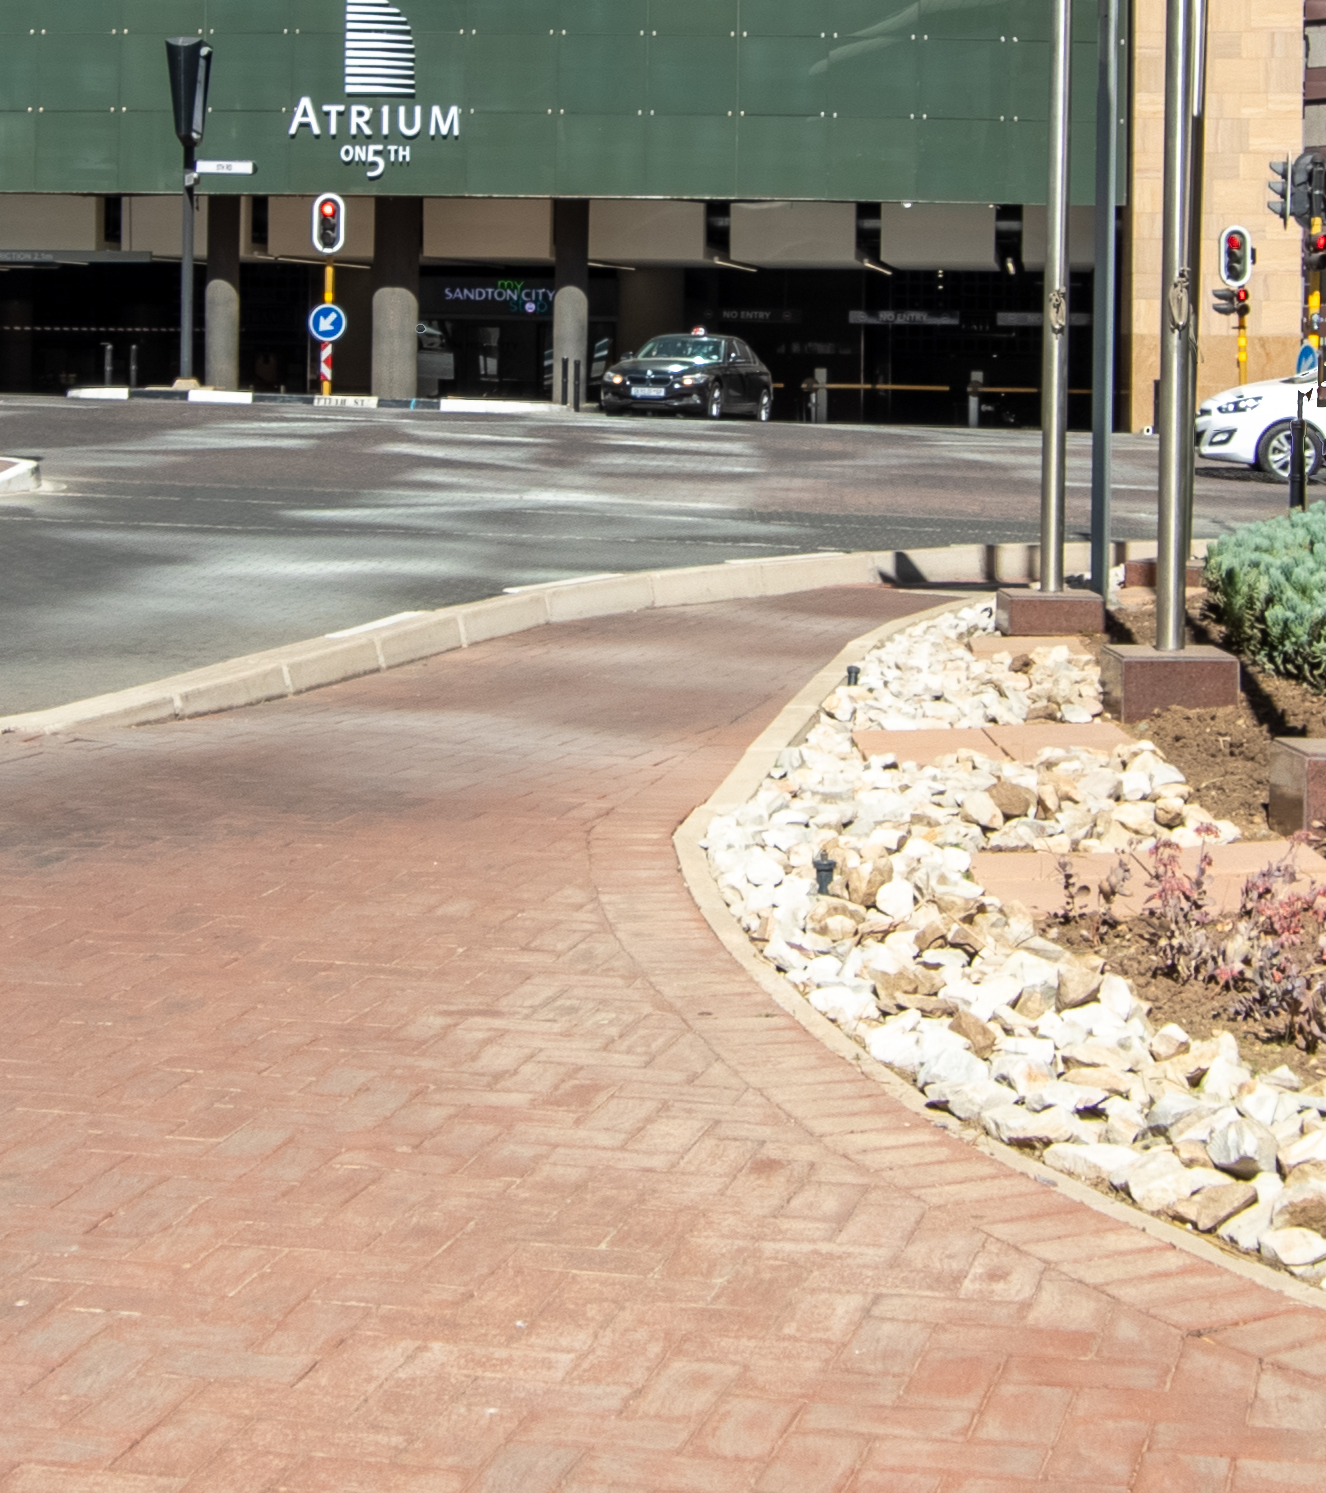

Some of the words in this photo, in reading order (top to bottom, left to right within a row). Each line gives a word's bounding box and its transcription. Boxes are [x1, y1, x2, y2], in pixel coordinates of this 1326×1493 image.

[288, 96, 461, 137] ATRIUM
[444, 287, 518, 302] SANDTON
[521, 288, 555, 302] CITY
[722, 310, 739, 319] NO
[740, 311, 772, 320] ENTRY
[878, 312, 895, 322] NO
[896, 312, 928, 322] ENTRY
